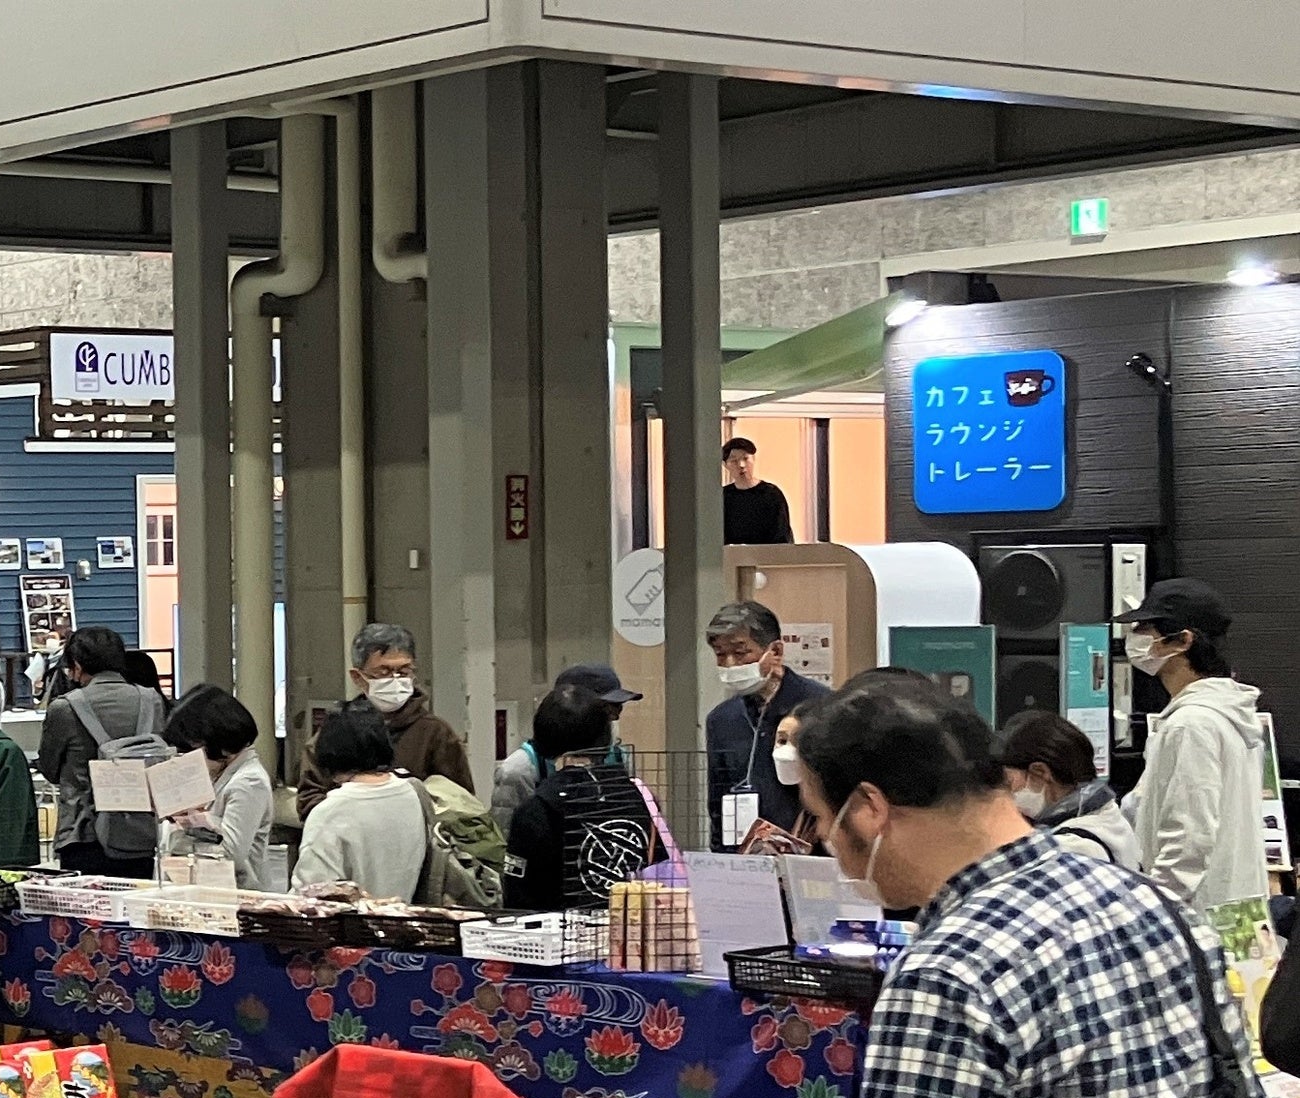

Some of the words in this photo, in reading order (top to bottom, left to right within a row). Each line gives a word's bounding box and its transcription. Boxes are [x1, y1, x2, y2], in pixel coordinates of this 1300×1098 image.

[926, 386, 995, 408] カフェ
[926, 419, 1025, 446] ラウンジ
[929, 457, 1052, 483] トレーラー
